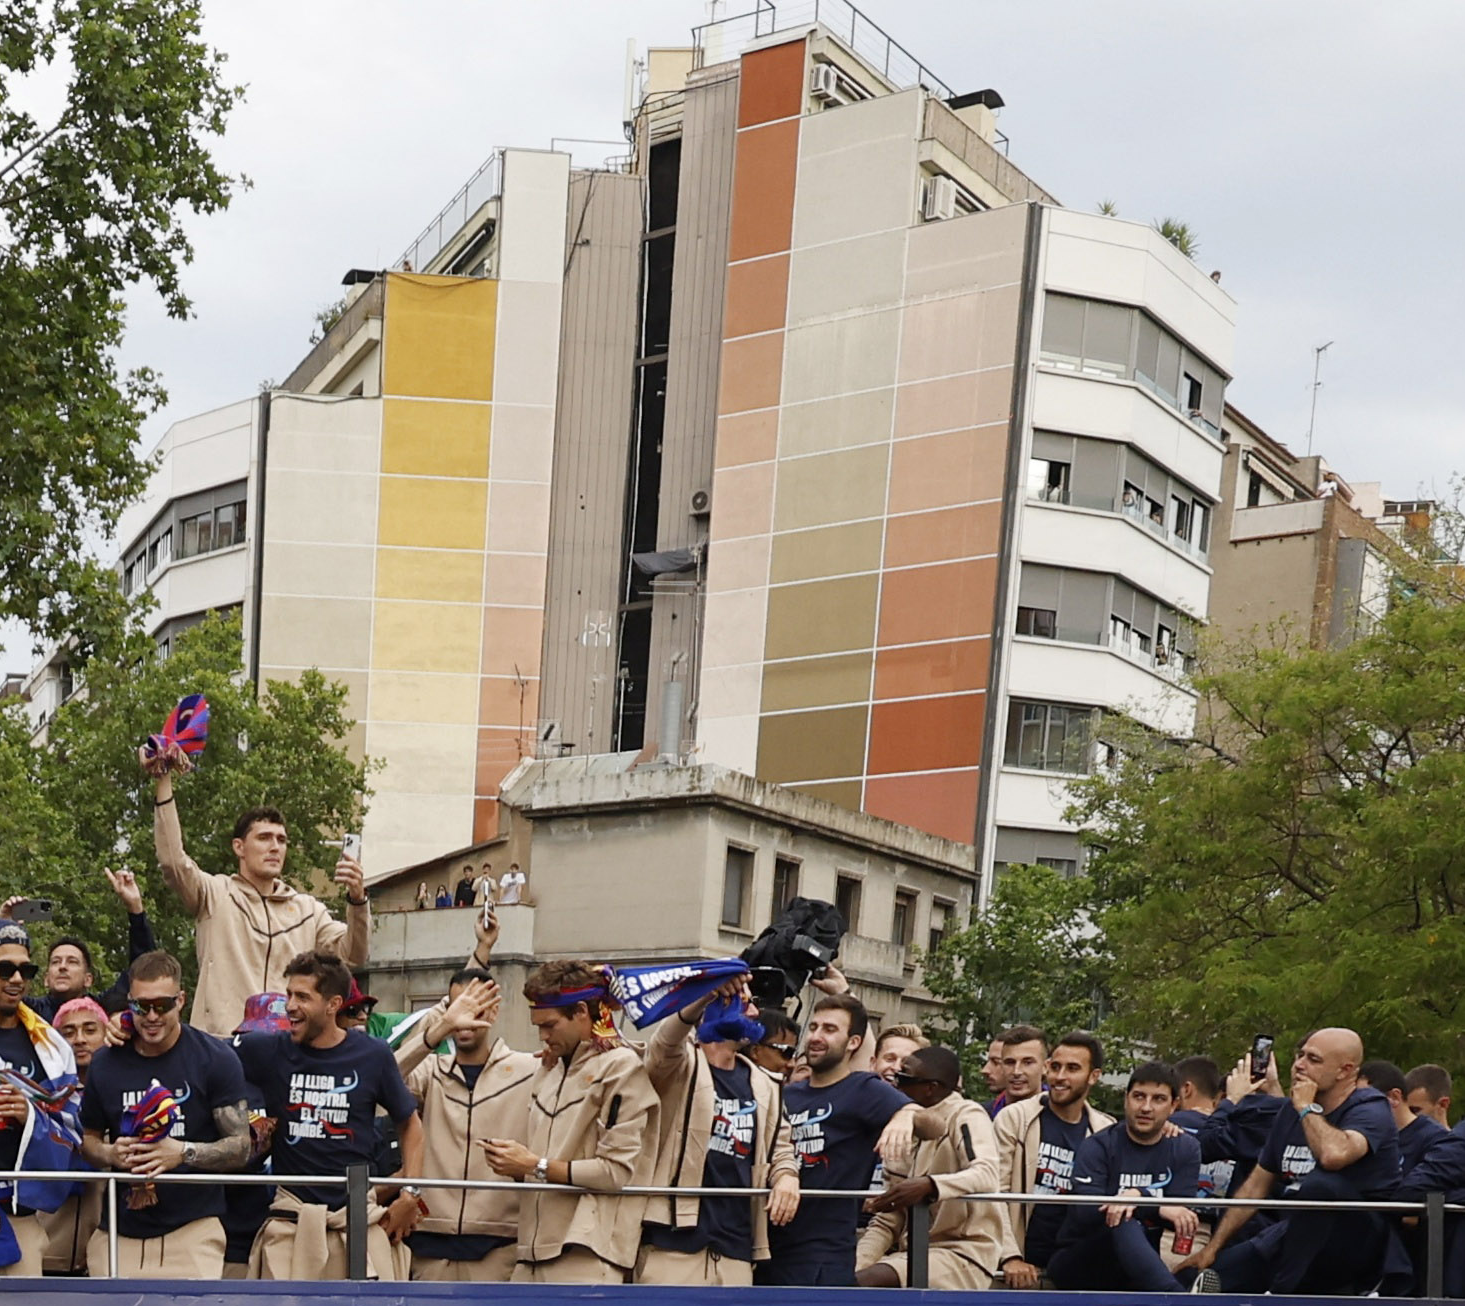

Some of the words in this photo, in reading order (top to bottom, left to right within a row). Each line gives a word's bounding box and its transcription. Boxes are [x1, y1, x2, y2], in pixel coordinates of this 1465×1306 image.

[290, 1073, 304, 1088] LA
[305, 1074, 335, 1090] LLIGA
[289, 1086, 303, 1104] ÉS
[300, 1106, 313, 1121] EL
